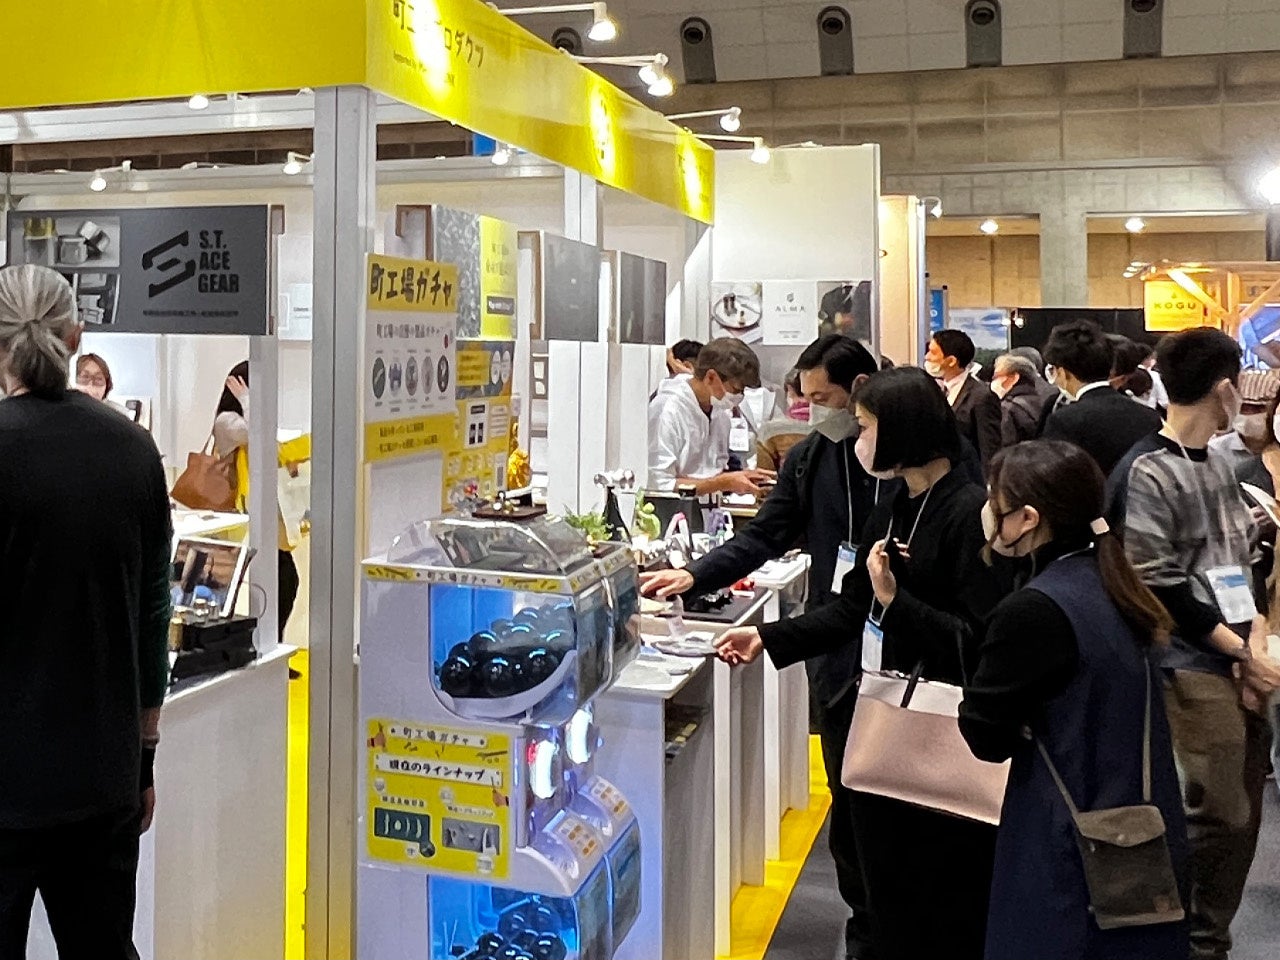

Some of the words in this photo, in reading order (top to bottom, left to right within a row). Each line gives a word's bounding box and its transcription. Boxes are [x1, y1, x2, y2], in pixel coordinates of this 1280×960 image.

[199, 230, 227, 249] S.T.
[200, 251, 230, 270] ACE
[198, 273, 239, 293] GEAR
[388, 758, 486, 781] 現在のラインナップ
